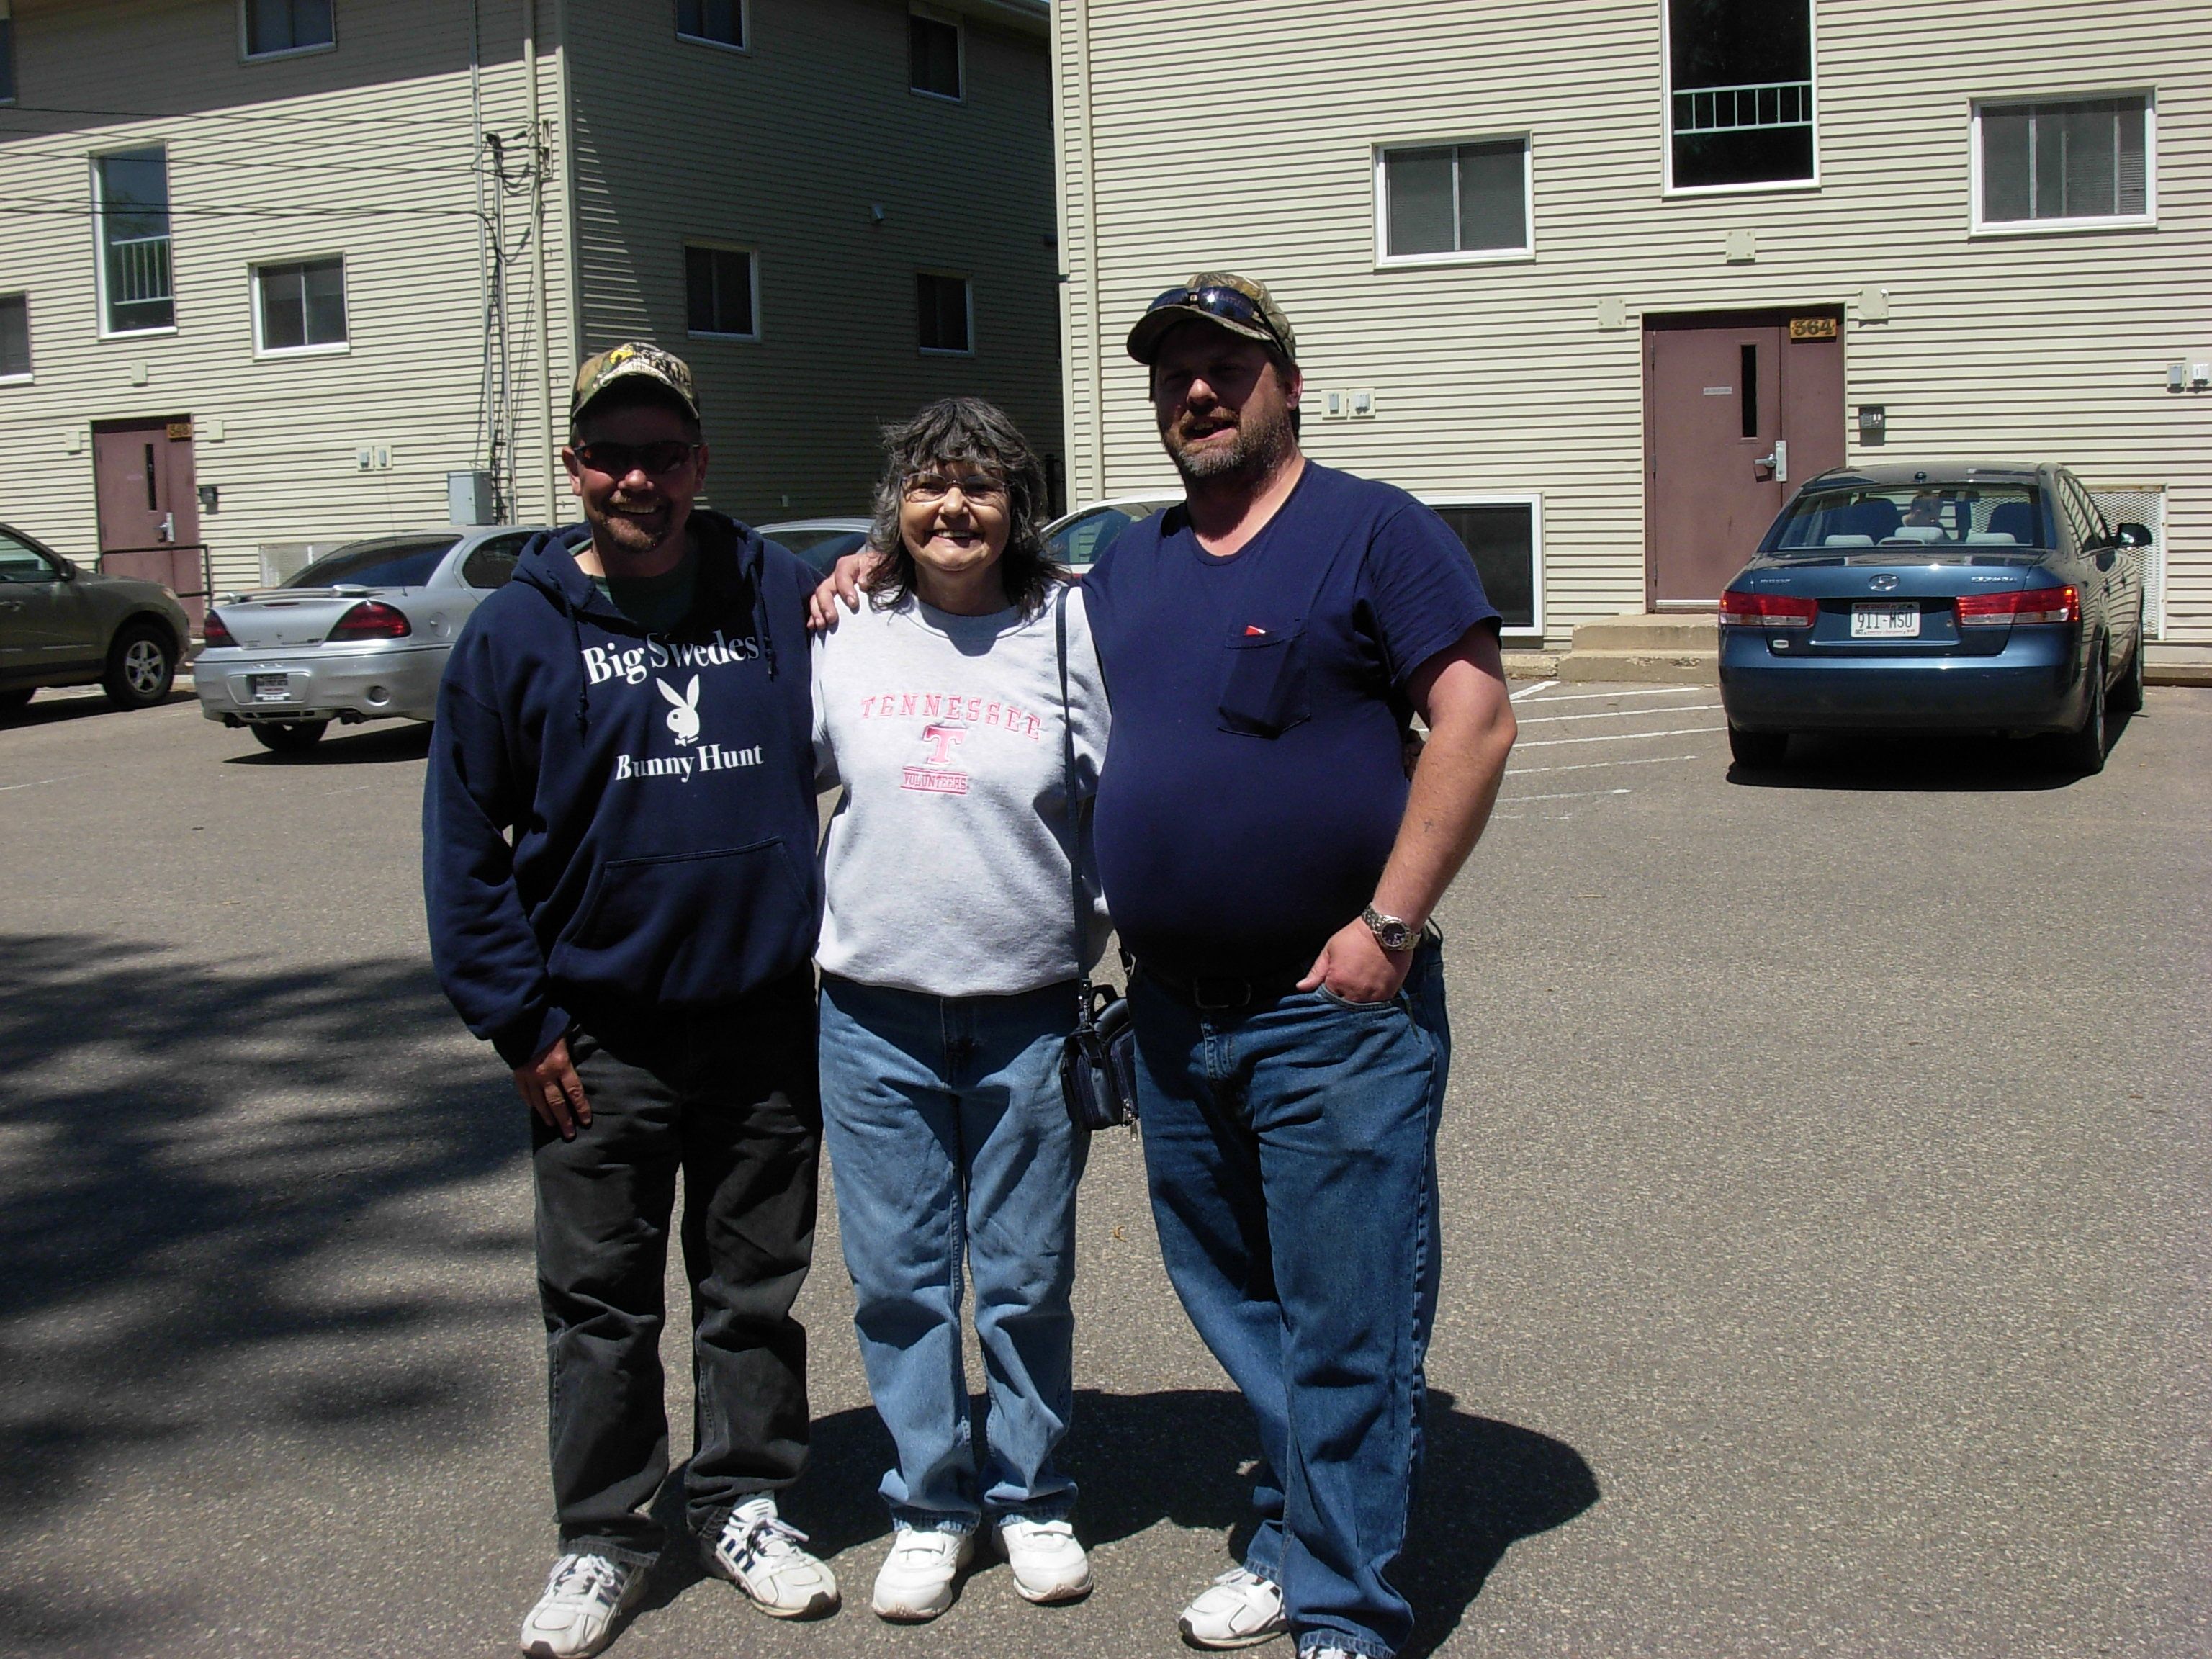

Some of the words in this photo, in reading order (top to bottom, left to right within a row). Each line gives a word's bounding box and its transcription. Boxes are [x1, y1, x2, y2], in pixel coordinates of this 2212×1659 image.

[1794, 319, 1833, 336] 364
[581, 642, 647, 685] Big
[646, 629, 760, 668] Swedes
[861, 693, 1043, 741] TENNESSEE
[615, 754, 695, 783] Bunny
[696, 744, 764, 772] Hunt
[921, 723, 968, 765] T
[904, 772, 968, 791] VOLUNTEERS
